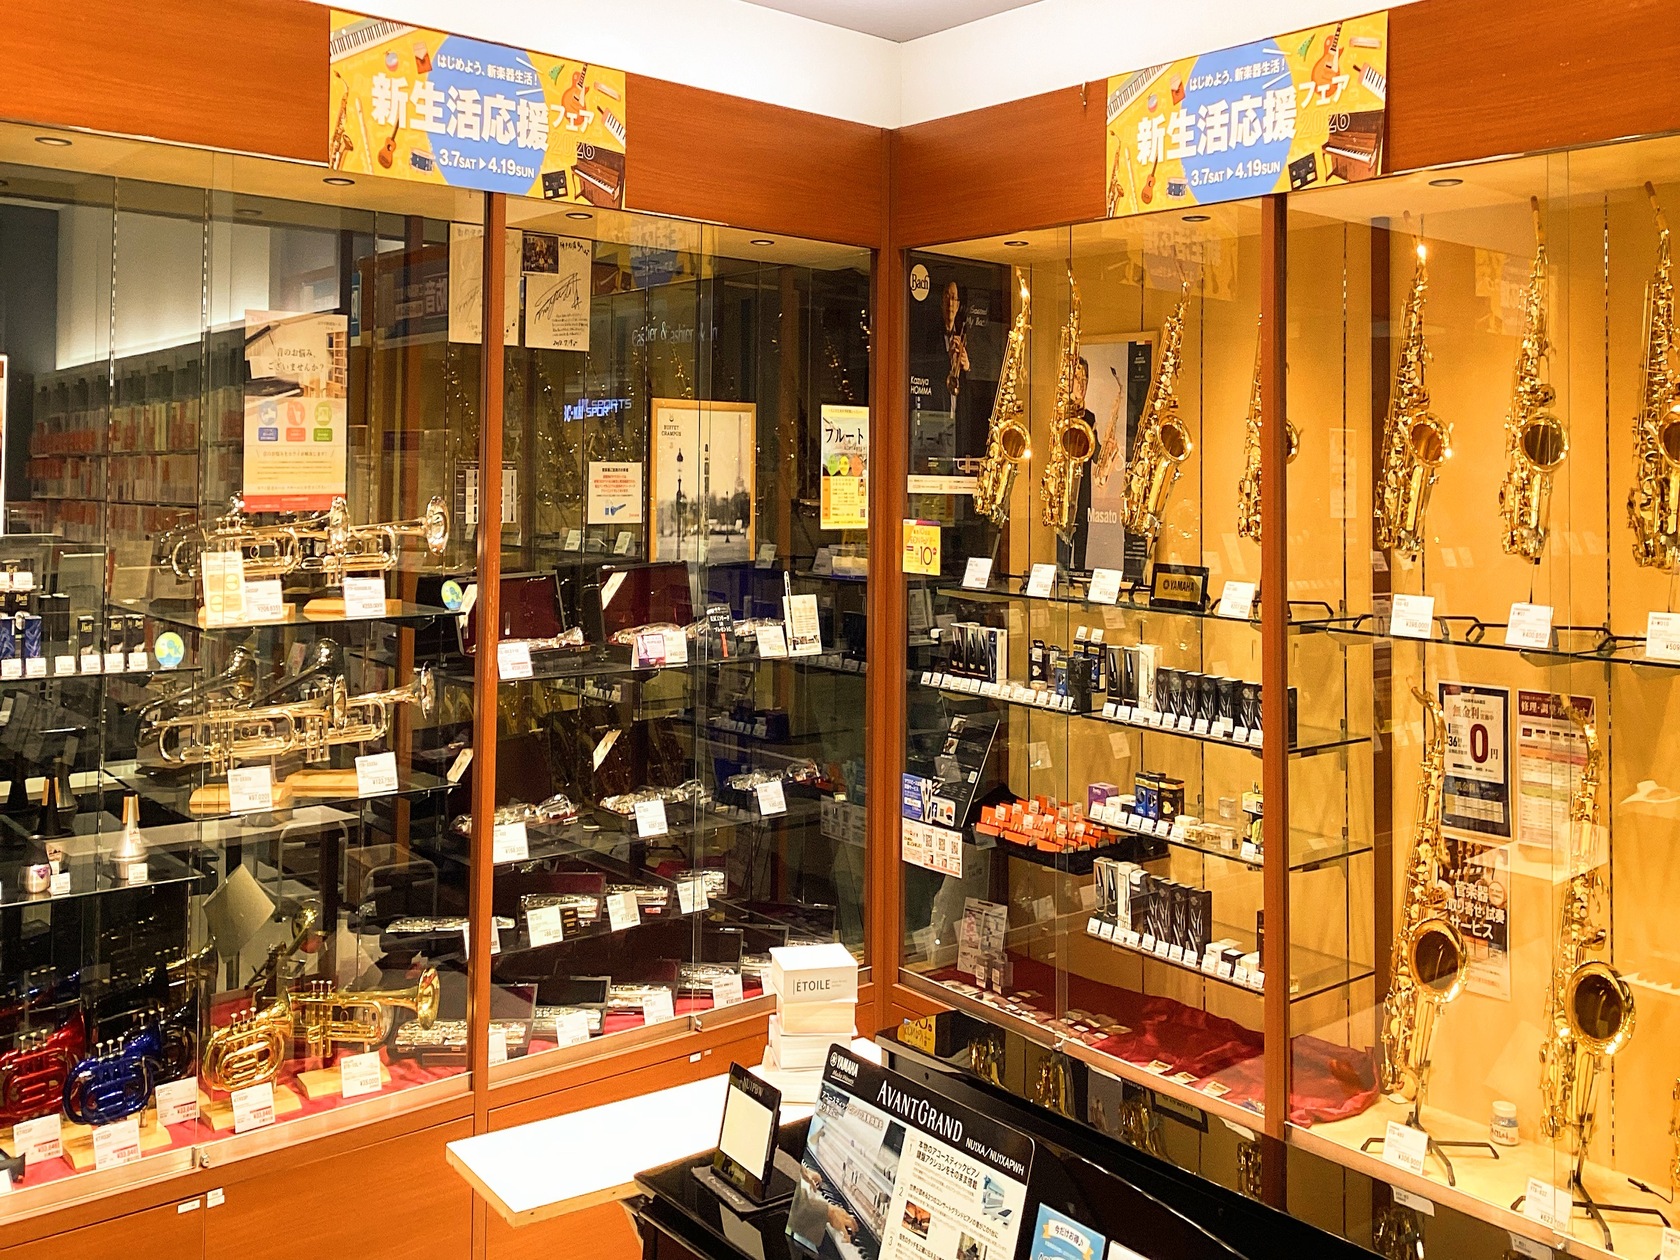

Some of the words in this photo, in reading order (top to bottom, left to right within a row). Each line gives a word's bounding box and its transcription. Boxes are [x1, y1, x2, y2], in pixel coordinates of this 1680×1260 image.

[911, 273, 930, 292] Bach
[825, 427, 864, 445] フルート
[1087, 508, 1117, 524] Masato
[1170, 579, 1195, 592] YAMAHA
[1455, 880, 1489, 903] 管楽器
[796, 977, 831, 992] ÉTOILE
[837, 1054, 859, 1078] YAMAHA
